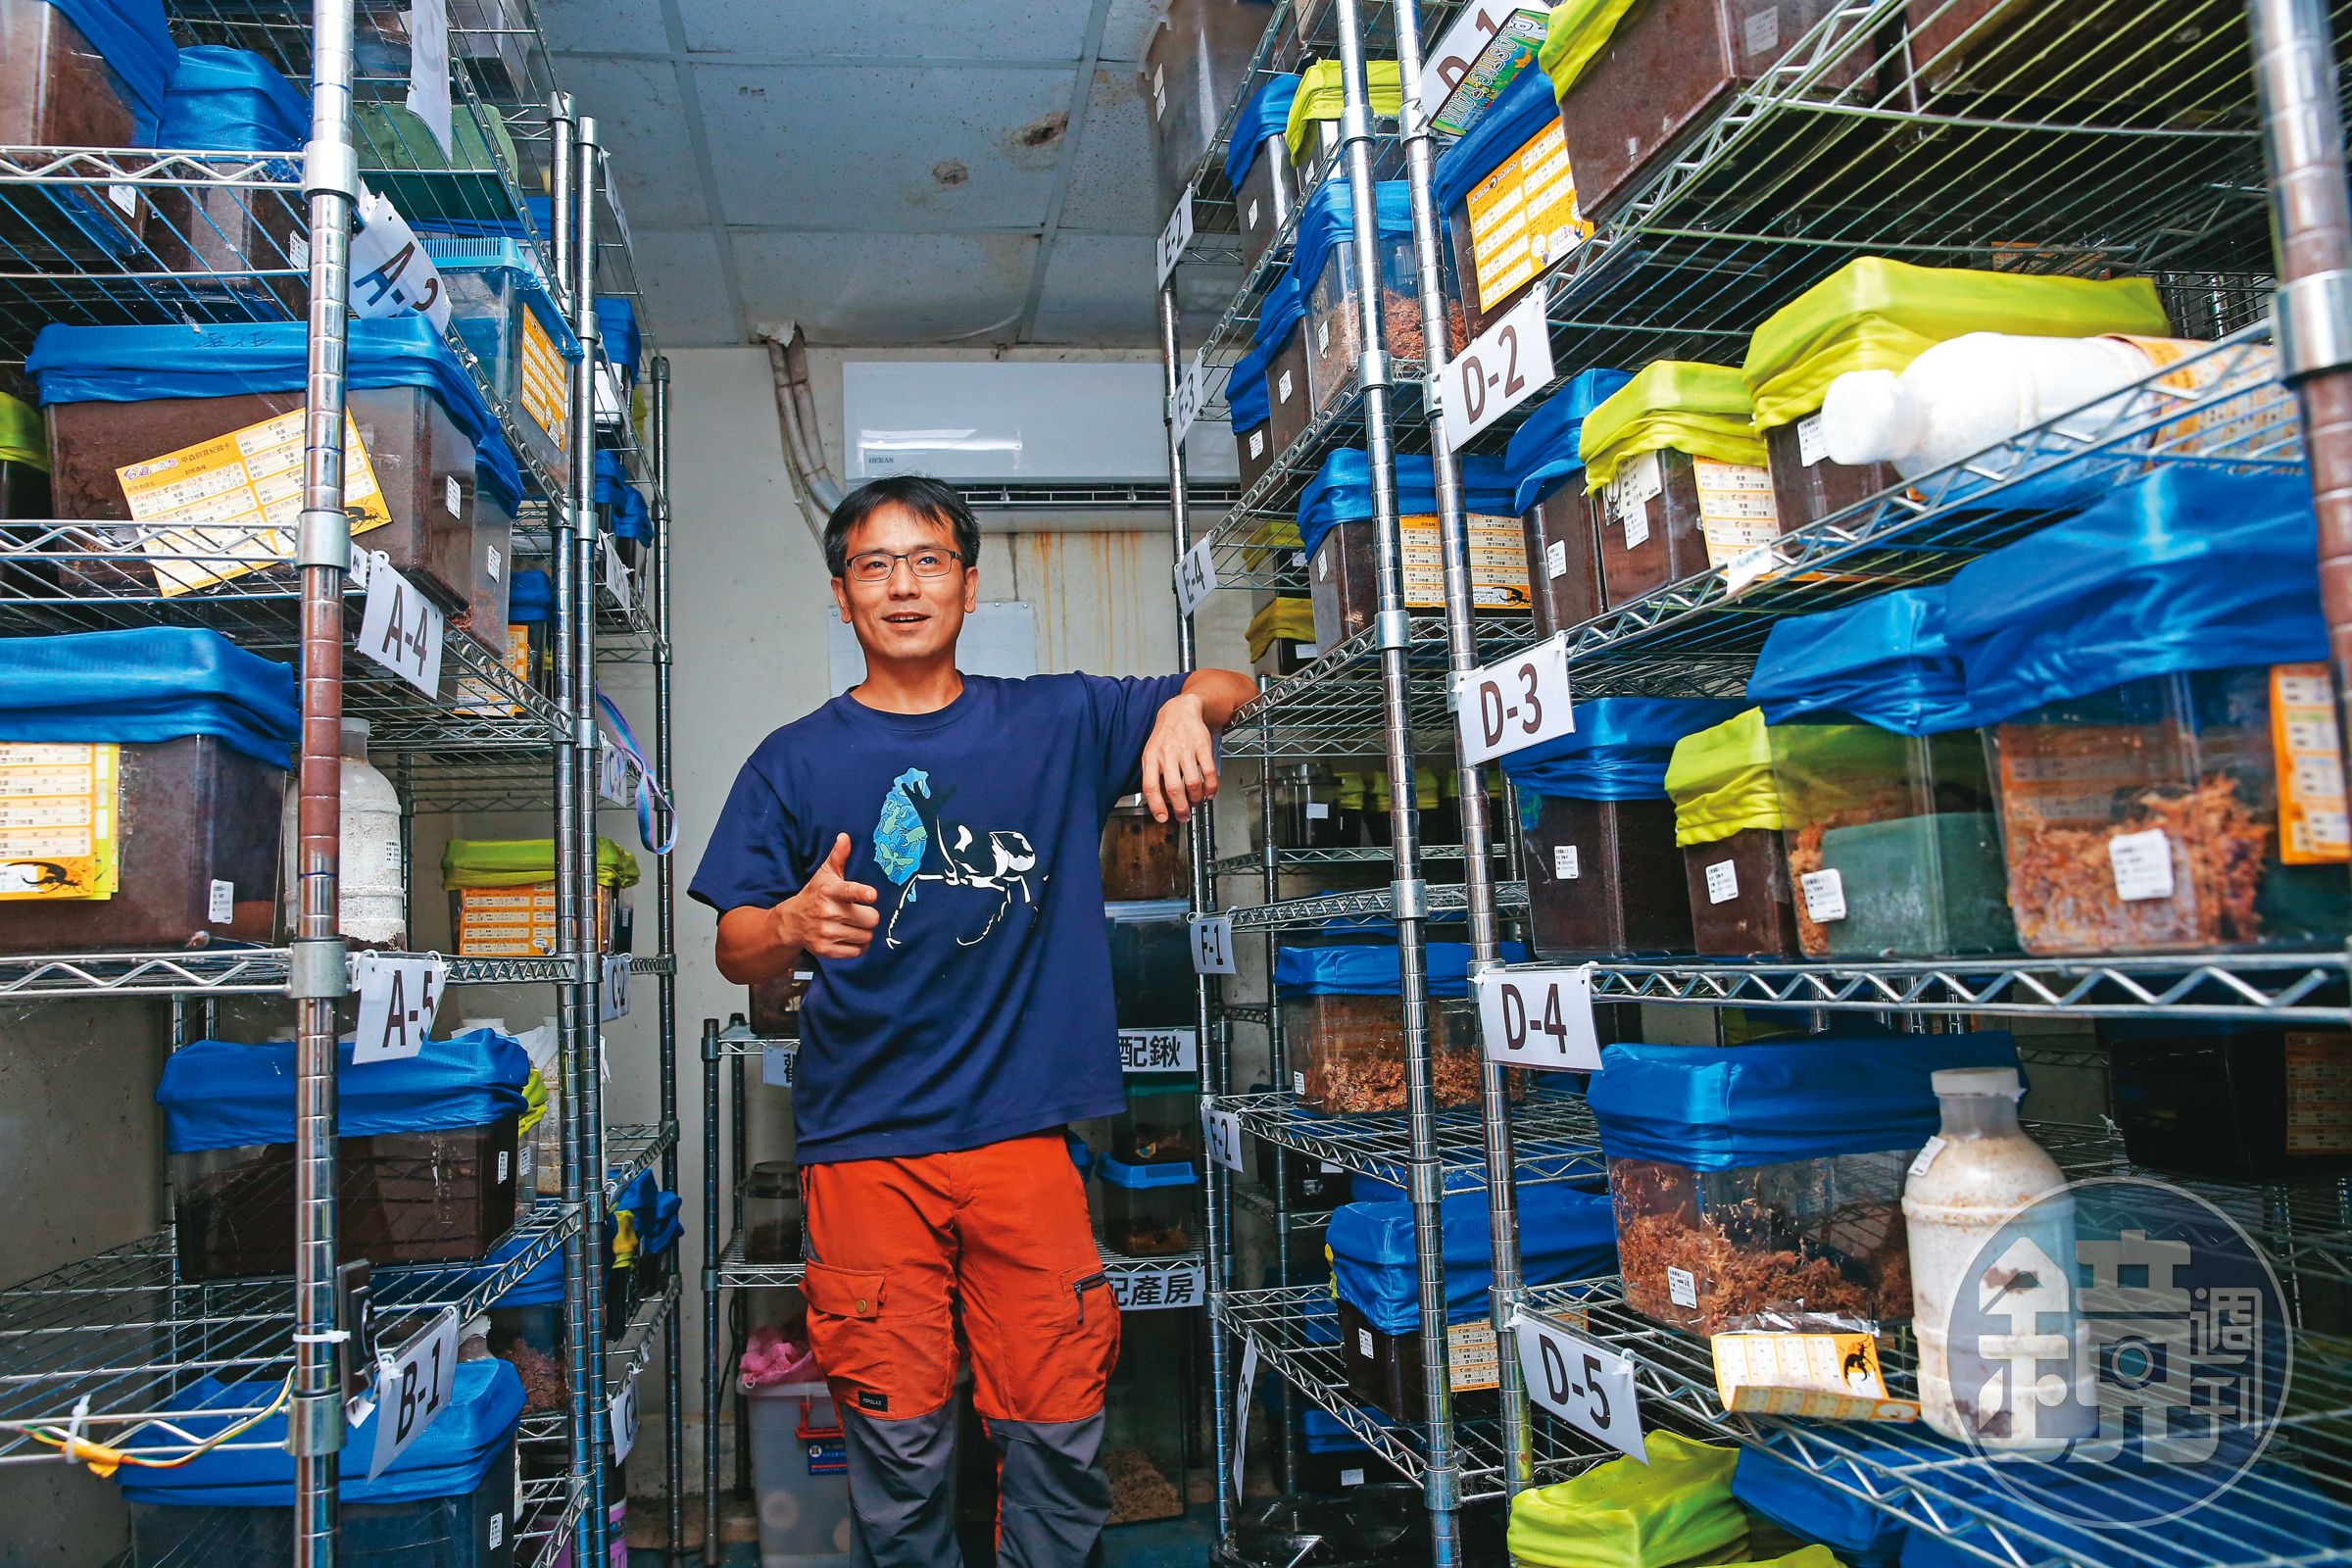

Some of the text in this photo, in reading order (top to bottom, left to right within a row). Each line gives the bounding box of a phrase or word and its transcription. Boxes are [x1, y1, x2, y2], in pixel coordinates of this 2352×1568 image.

[1164, 207, 1184, 269] E-2
[1178, 372, 1195, 429] E-3
[1461, 324, 1525, 424] D-2
[1182, 551, 1205, 604] E-4
[381, 583, 427, 677] A-4
[1480, 662, 1543, 748] D-3
[1200, 924, 1224, 966] F-1
[382, 970, 434, 1048] A-5
[612, 963, 625, 1010] C-2
[1501, 983, 1567, 1054] D-4
[1118, 1035, 1181, 1067] 配鍬
[1209, 1115, 1232, 1161] F-2
[395, 1337, 441, 1446] B-1
[1539, 1333, 1611, 1430] D-5
